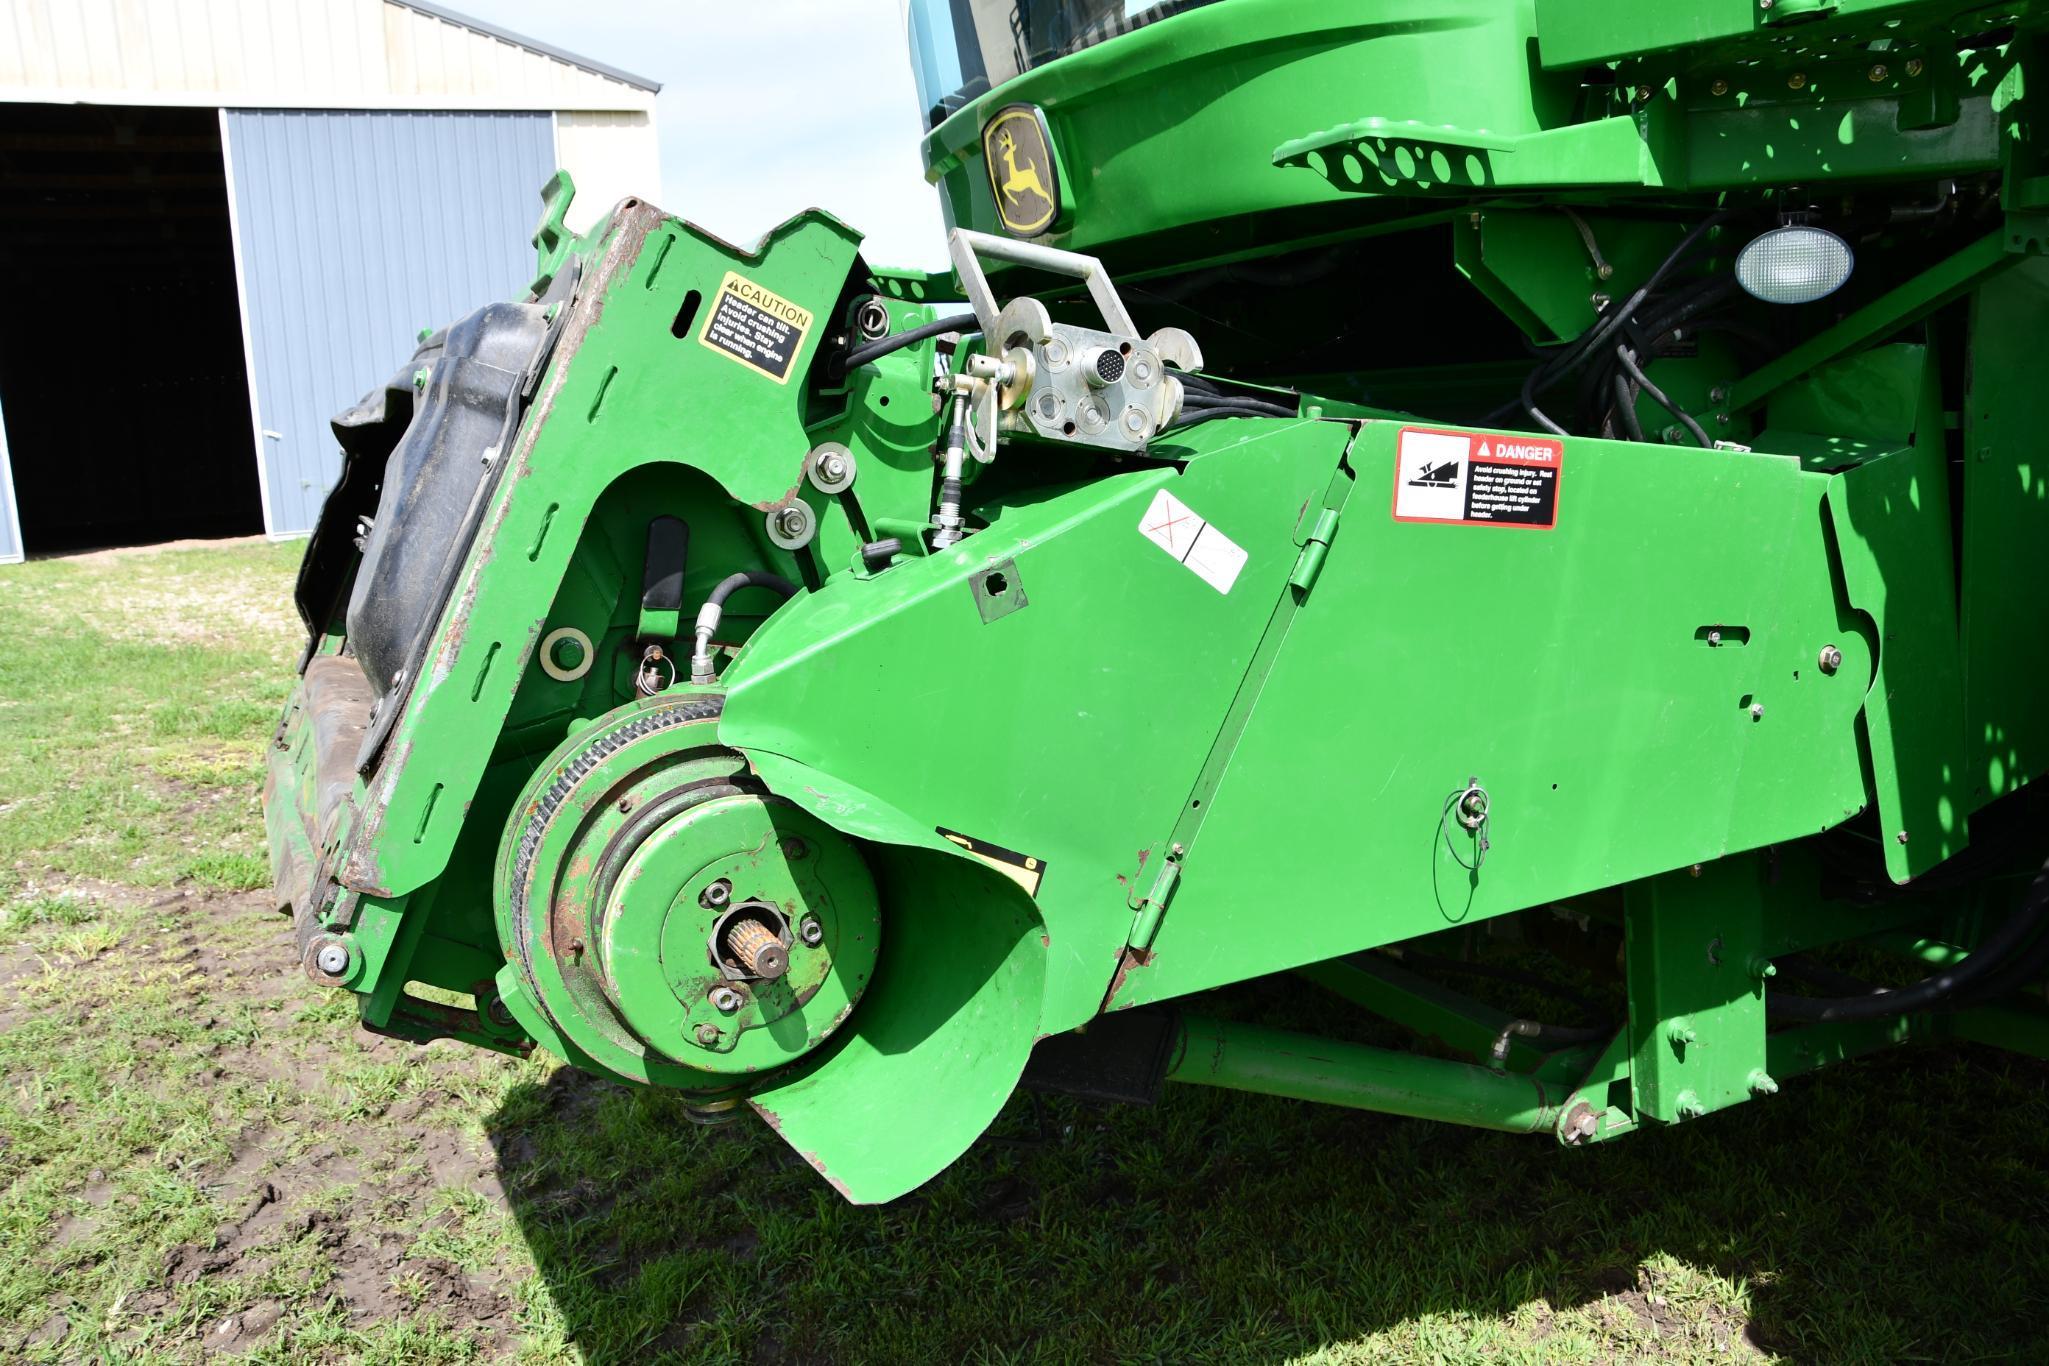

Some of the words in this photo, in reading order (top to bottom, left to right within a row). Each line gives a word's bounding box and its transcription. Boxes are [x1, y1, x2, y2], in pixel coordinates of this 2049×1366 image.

[741, 284, 808, 327] CAUTION
[725, 294, 757, 316] Header
[758, 313, 774, 326] can
[776, 321, 790, 335] tilt.
[721, 304, 747, 322] Avoid
[747, 318, 785, 343] crushing
[710, 330, 718, 340] is
[719, 336, 752, 358] running.
[714, 323, 734, 337] clear
[734, 333, 757, 348] when
[756, 344, 783, 362] engine
[754, 331, 774, 348] Stay
[1496, 444, 1552, 461] DANGER
[1493, 468, 1518, 477] crushing
[1519, 469, 1537, 478] injury.
[1473, 484, 1491, 492] safety
[1492, 486, 1506, 494] stop,
[1508, 486, 1529, 494] located
[1472, 492, 1508, 501] feederhouse
[1518, 496, 1540, 504] cylinder
[1491, 503, 1512, 512] getting
